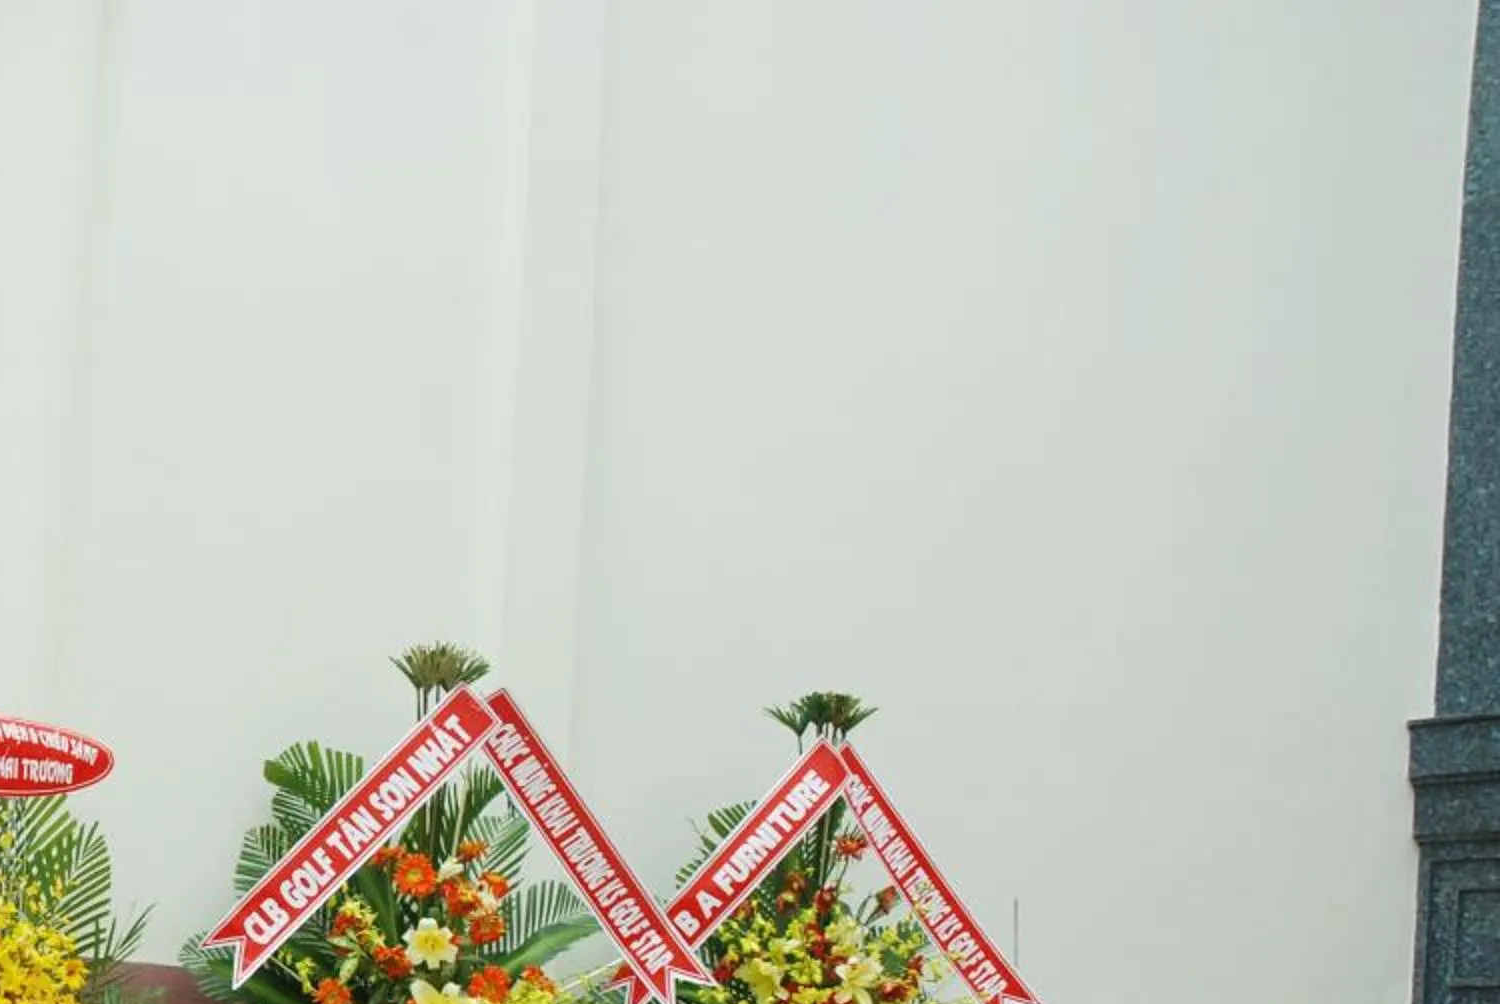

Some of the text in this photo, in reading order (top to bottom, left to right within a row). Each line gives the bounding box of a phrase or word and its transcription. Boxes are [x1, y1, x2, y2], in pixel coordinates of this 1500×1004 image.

[243, 897, 290, 944] CLB
[280, 847, 337, 909] GOLF
[535, 792, 581, 839] KHAI
[608, 898, 650, 939] GOLF
[629, 929, 674, 975] STAR
[711, 768, 831, 897] FURNITURE
